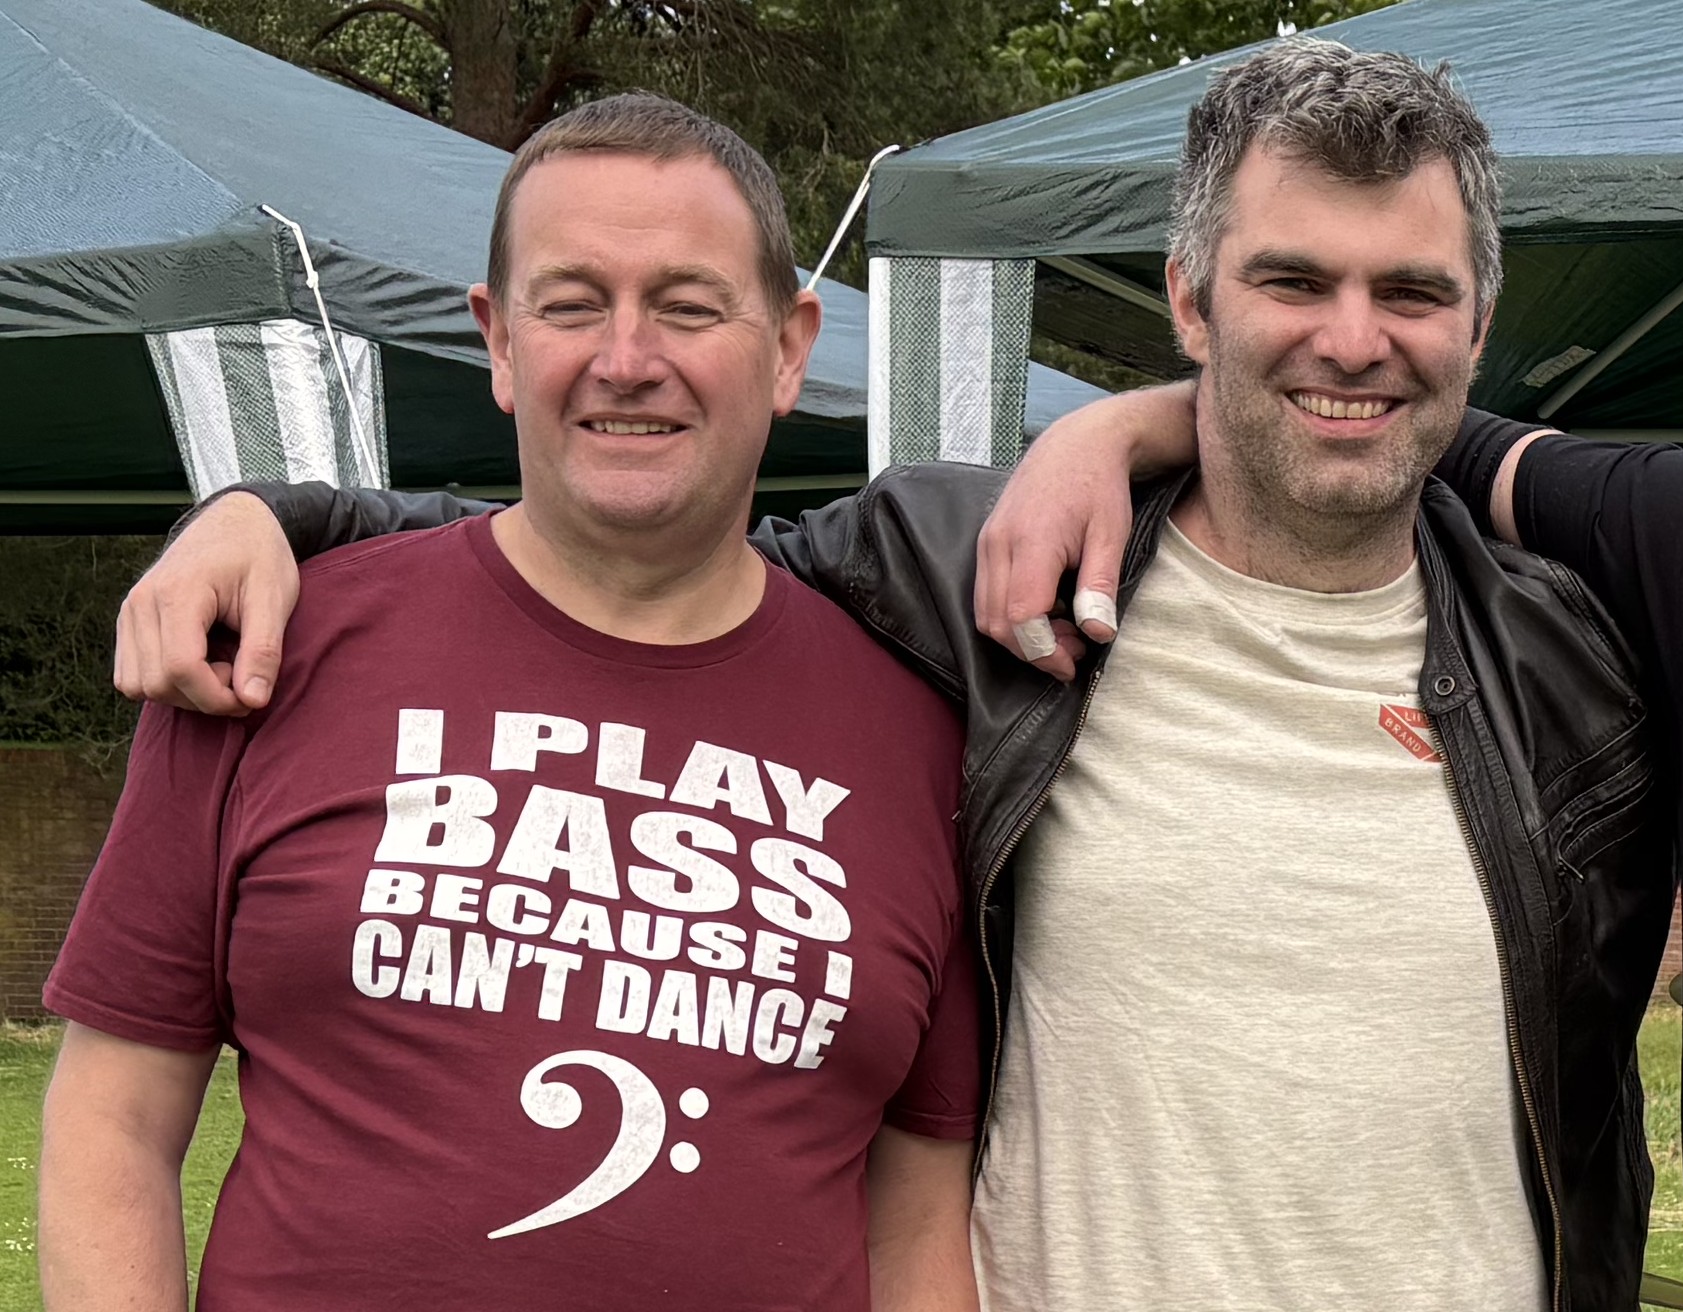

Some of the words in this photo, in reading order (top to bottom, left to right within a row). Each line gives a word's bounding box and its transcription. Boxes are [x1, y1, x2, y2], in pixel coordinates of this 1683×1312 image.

[395, 708, 444, 775] I
[490, 710, 851, 842] PLAY
[1384, 717, 1422, 753] BRAND
[373, 774, 852, 942] BASS
[351, 918, 583, 1022] CAN'T
[595, 959, 848, 1070] DANCE
[359, 868, 799, 983] BECAUSE
[824, 950, 853, 1000] I
